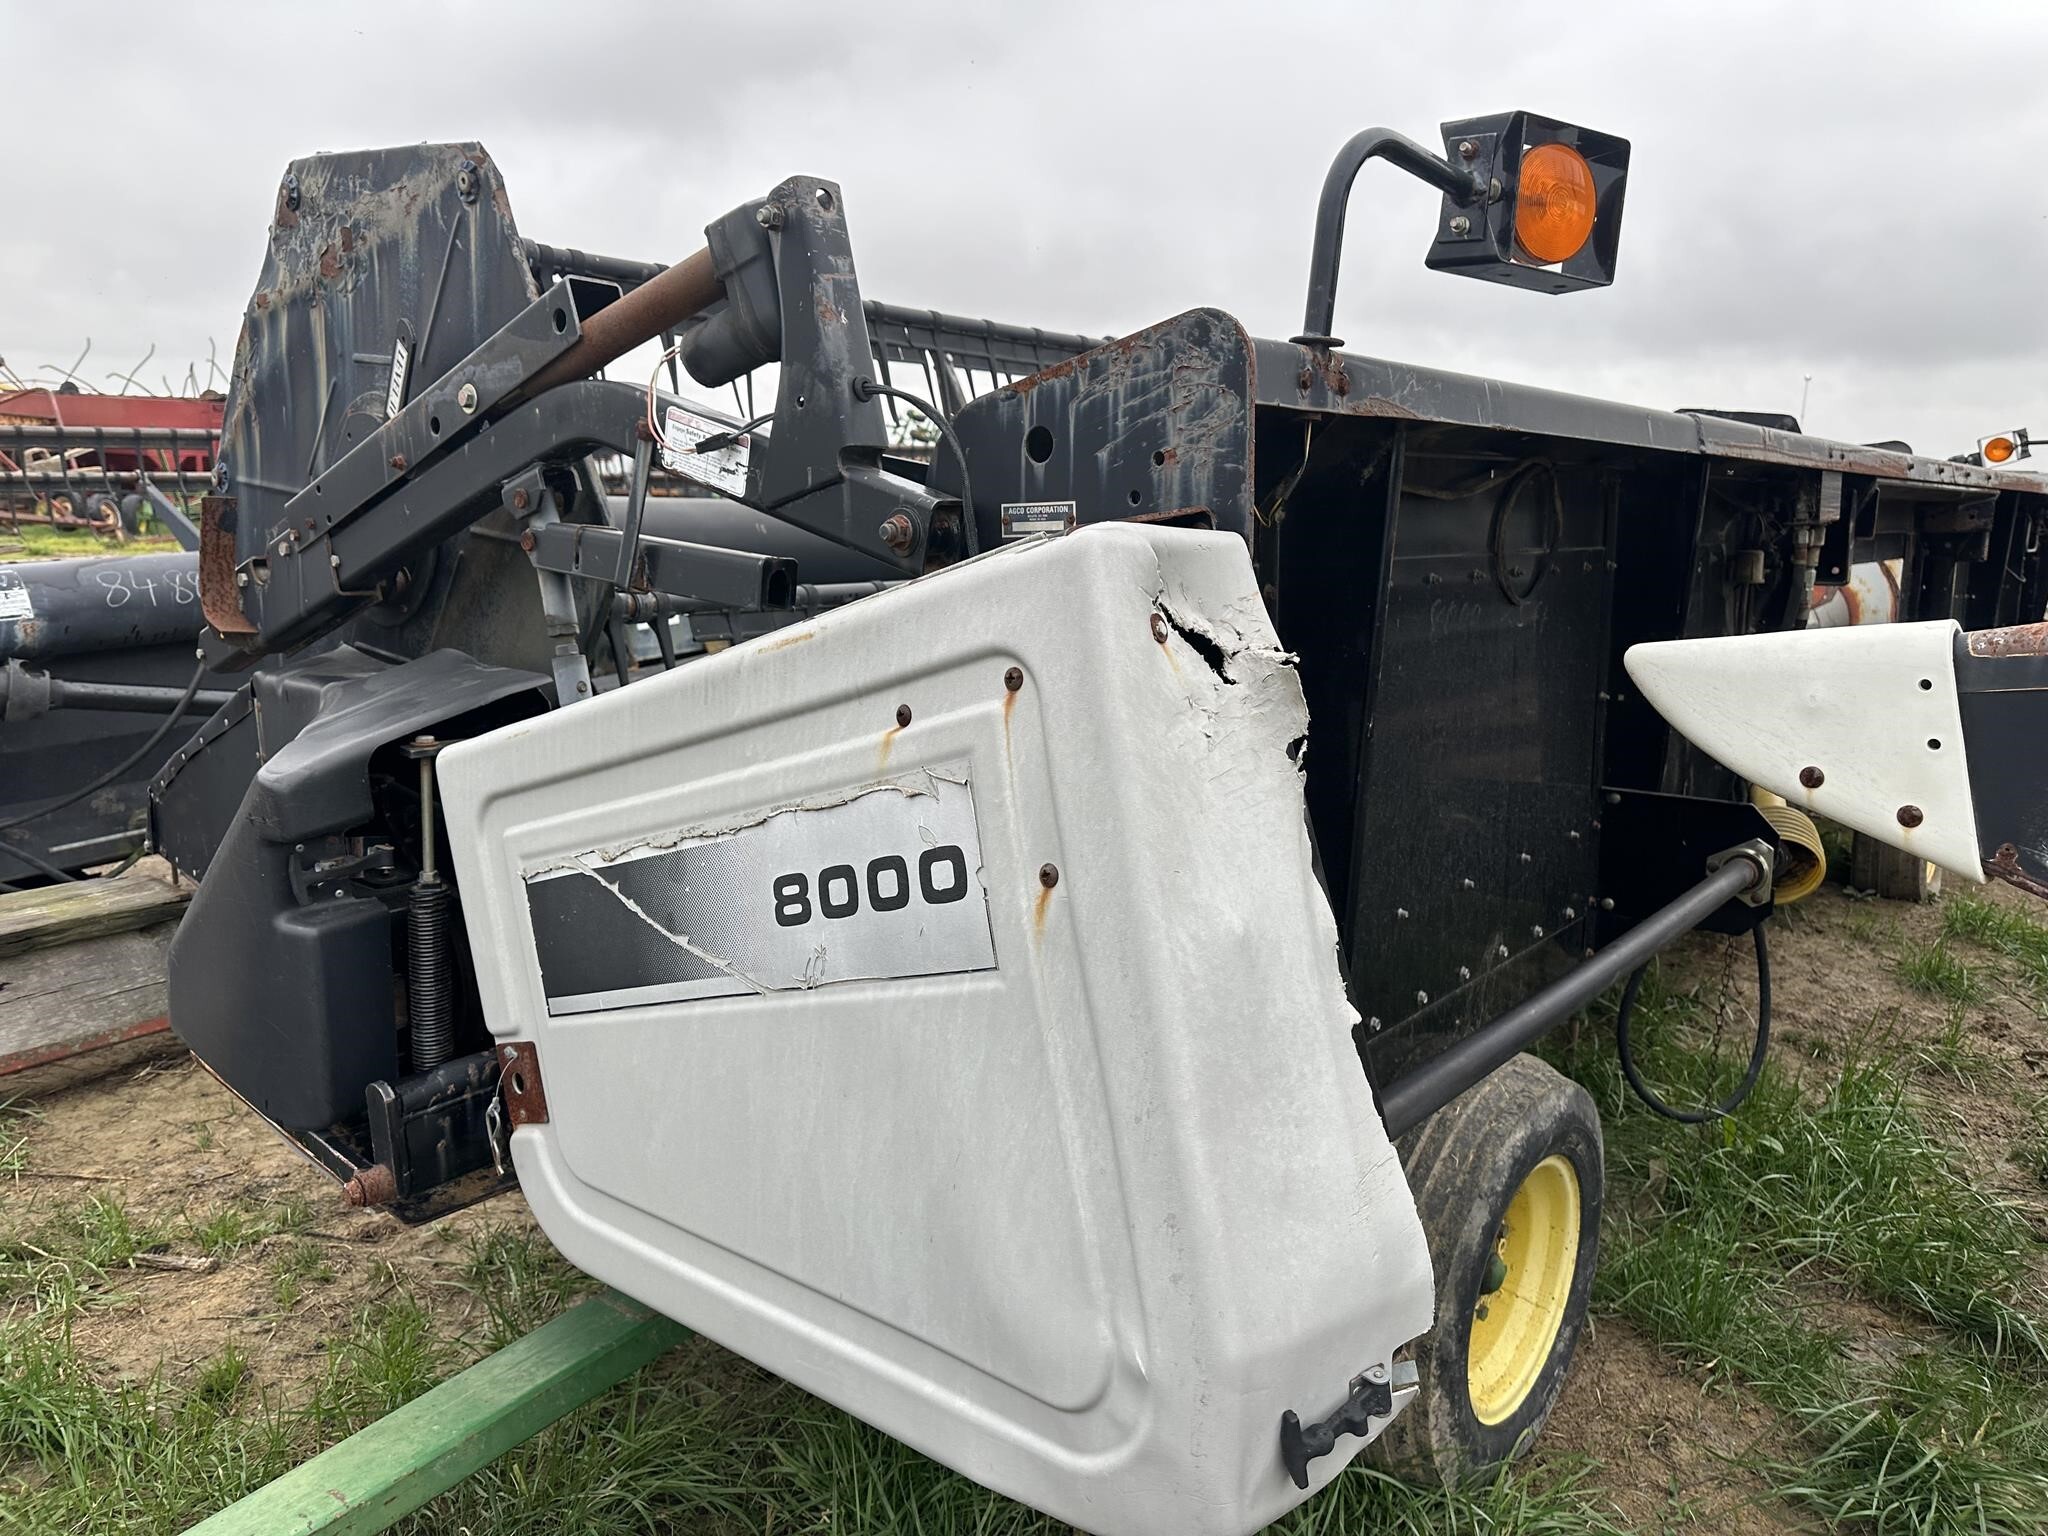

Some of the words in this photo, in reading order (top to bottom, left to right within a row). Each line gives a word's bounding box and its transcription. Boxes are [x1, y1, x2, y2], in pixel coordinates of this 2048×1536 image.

[686, 428, 702, 440] Safety
[1008, 507, 1025, 515] AGCO
[1025, 505, 1069, 514] CORPORATION
[772, 844, 968, 927] 8000
